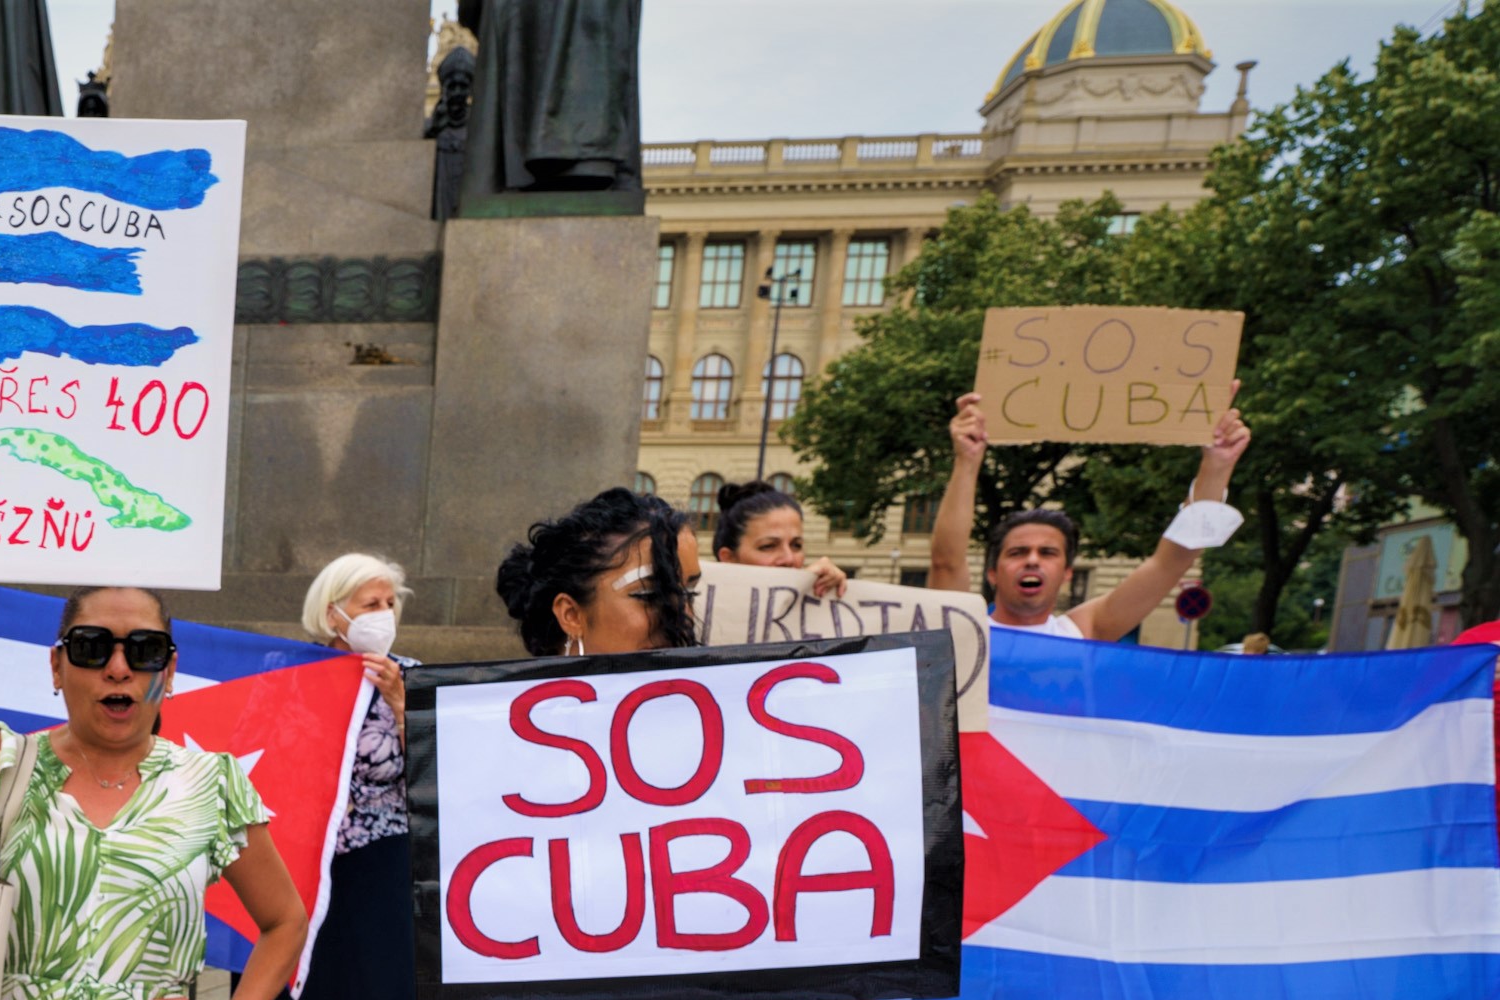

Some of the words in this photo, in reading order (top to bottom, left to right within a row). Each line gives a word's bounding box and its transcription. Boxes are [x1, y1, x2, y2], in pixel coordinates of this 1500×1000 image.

[1002, 377, 1214, 432] CUBA
[502, 662, 865, 818] SOS
[446, 810, 895, 960] CUBA
